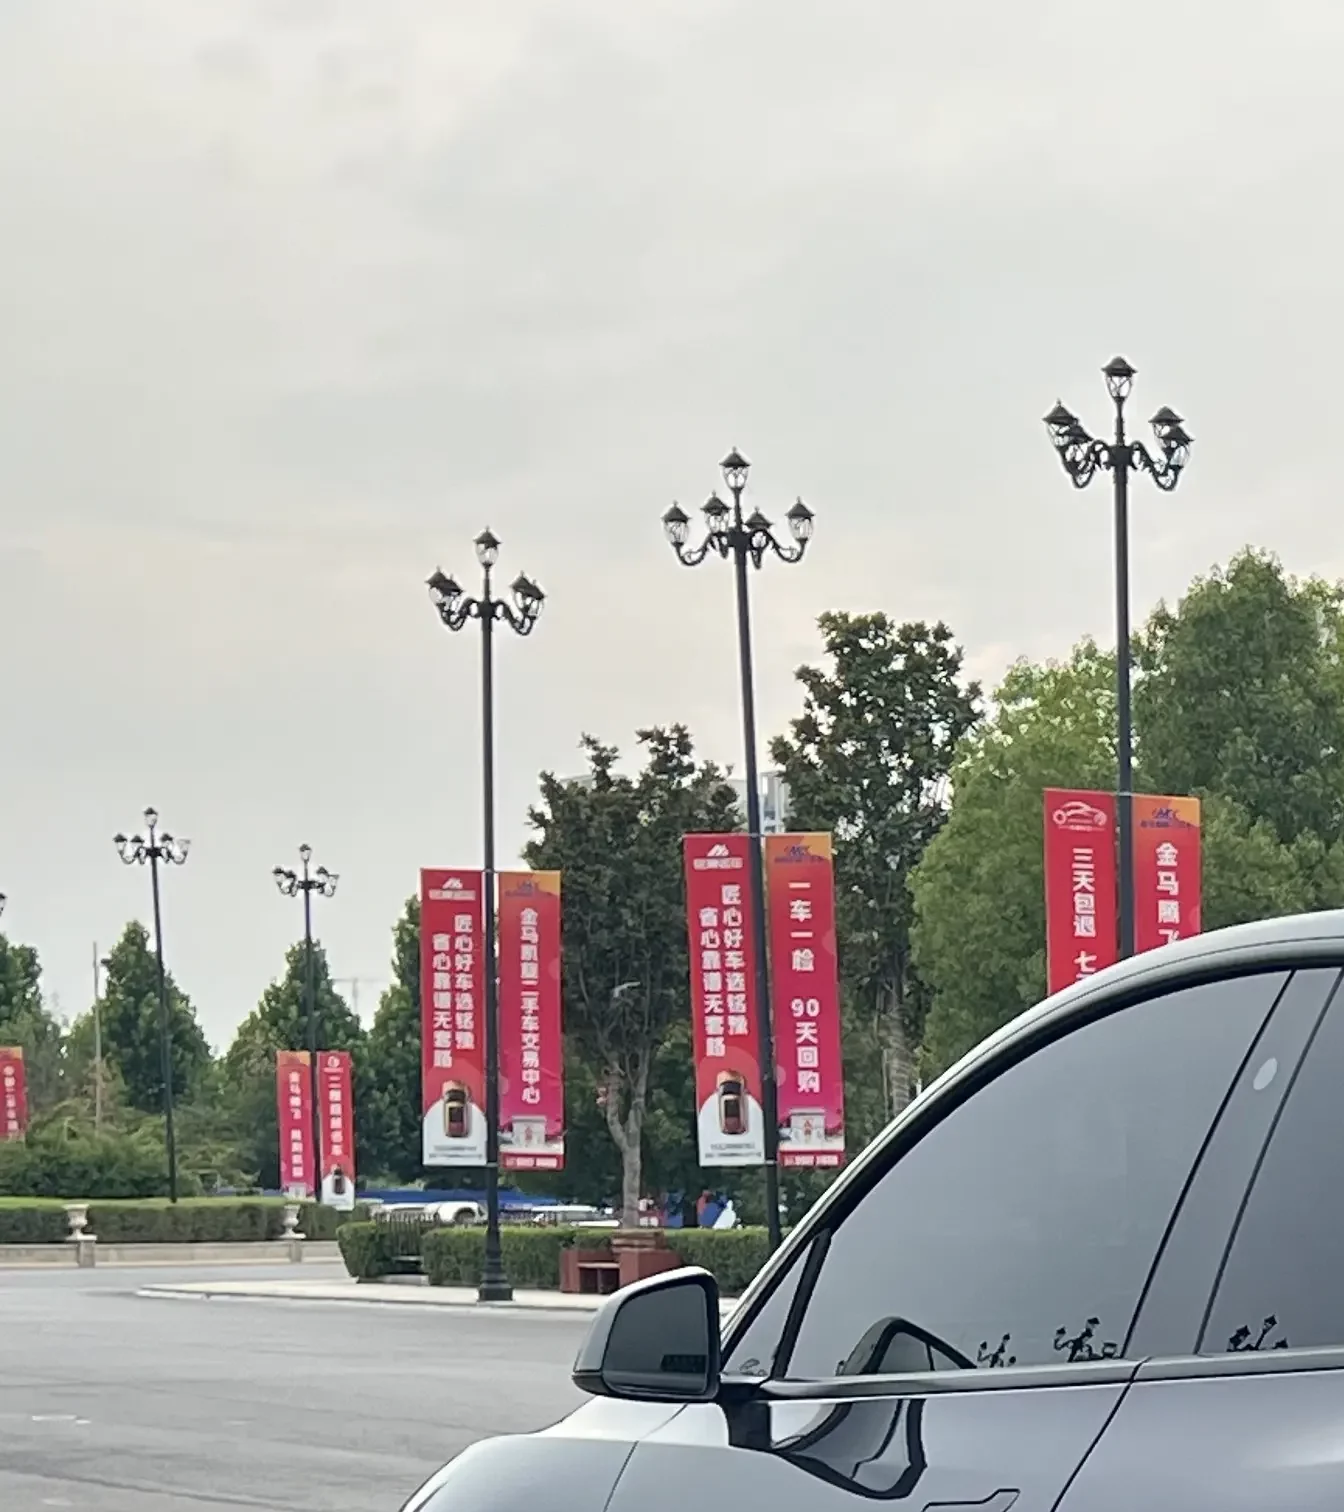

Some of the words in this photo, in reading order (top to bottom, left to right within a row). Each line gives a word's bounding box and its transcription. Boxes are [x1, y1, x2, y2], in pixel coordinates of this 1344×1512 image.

[1074, 950, 1098, 981] 七
[791, 998, 821, 1094] 90天回购
